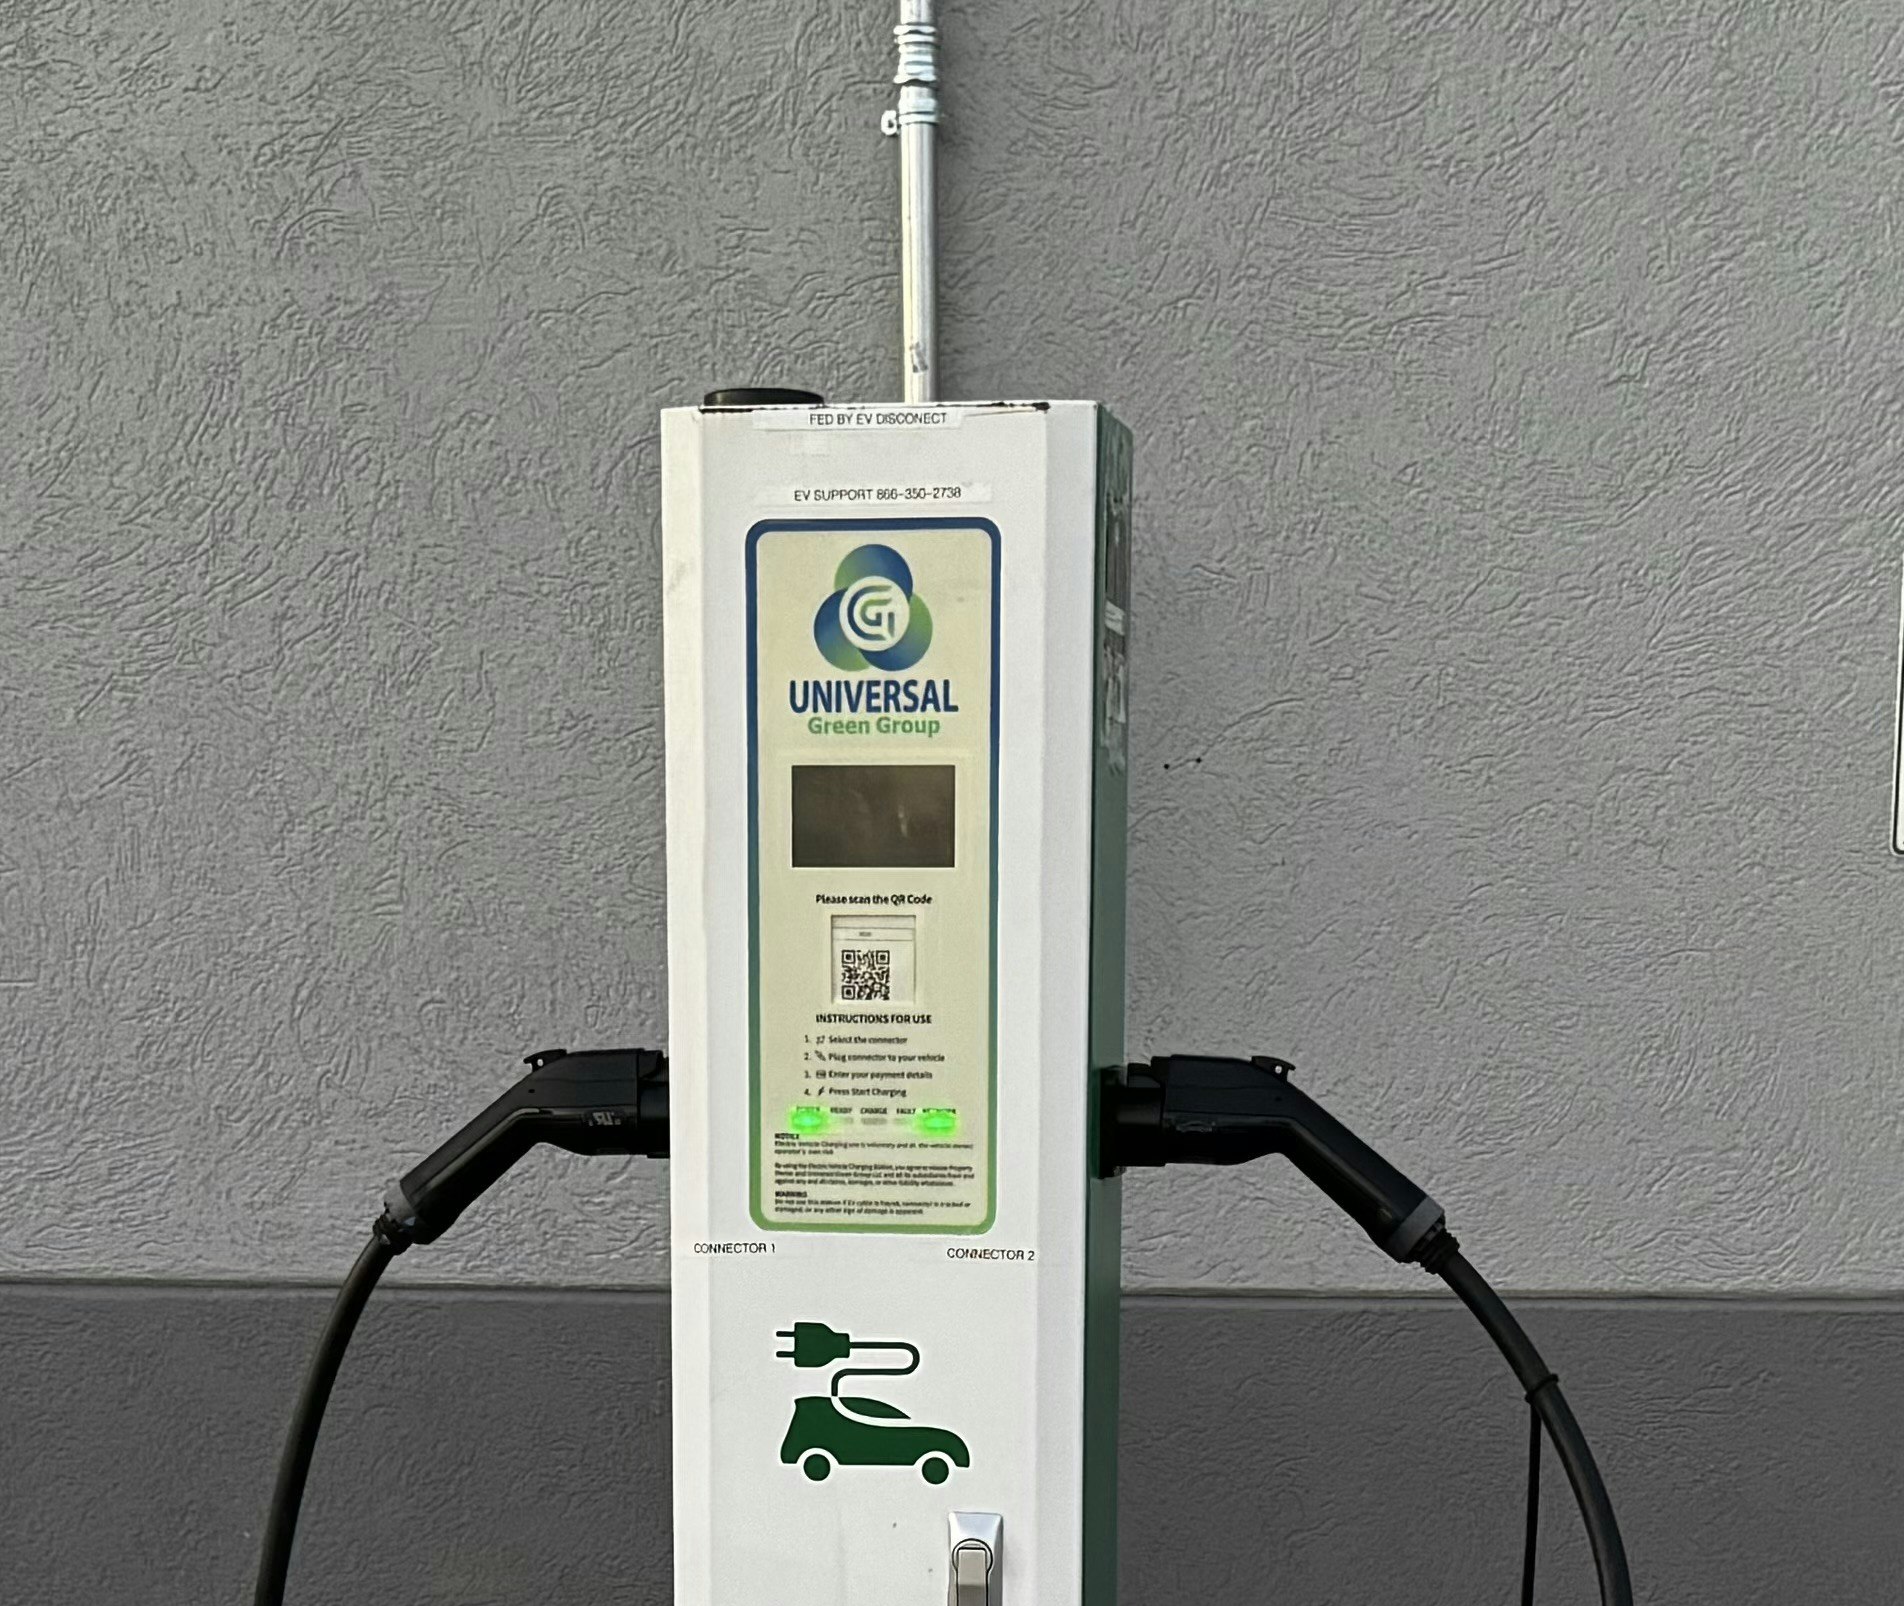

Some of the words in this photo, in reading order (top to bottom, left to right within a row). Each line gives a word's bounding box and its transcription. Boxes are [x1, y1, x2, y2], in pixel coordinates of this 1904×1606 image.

[809, 413, 834, 426] FED
[836, 413, 854, 426] BY
[856, 412, 873, 426] EV
[875, 412, 948, 425] DISCONECT
[793, 489, 811, 502] EV
[813, 488, 873, 502] SUPPORT
[789, 678, 960, 714] UNIVERSAL
[807, 716, 871, 735] Green
[875, 715, 941, 739] Group
[815, 893, 848, 905] Please
[848, 895, 871, 905] scan
[872, 894, 889, 905] the
[890, 893, 906, 907] QR
[906, 893, 933, 905] Code
[815, 1013, 890, 1025] INSTRUCTIONS
[890, 1013, 911, 1024] FOR
[911, 1014, 932, 1025] USE
[854, 1035, 867, 1044] the
[848, 1054, 886, 1062] connector
[898, 1055, 916, 1063] your
[851, 1071, 868, 1080] your
[828, 1087, 850, 1096] Press
[851, 1087, 870, 1096] Start
[872, 1088, 906, 1098] Charging
[693, 1242, 767, 1254] CONNECTOR
[771, 1243, 776, 1254] 1
[946, 1247, 1025, 1261] CONNECTOR
[1027, 1250, 1035, 1262] 2
